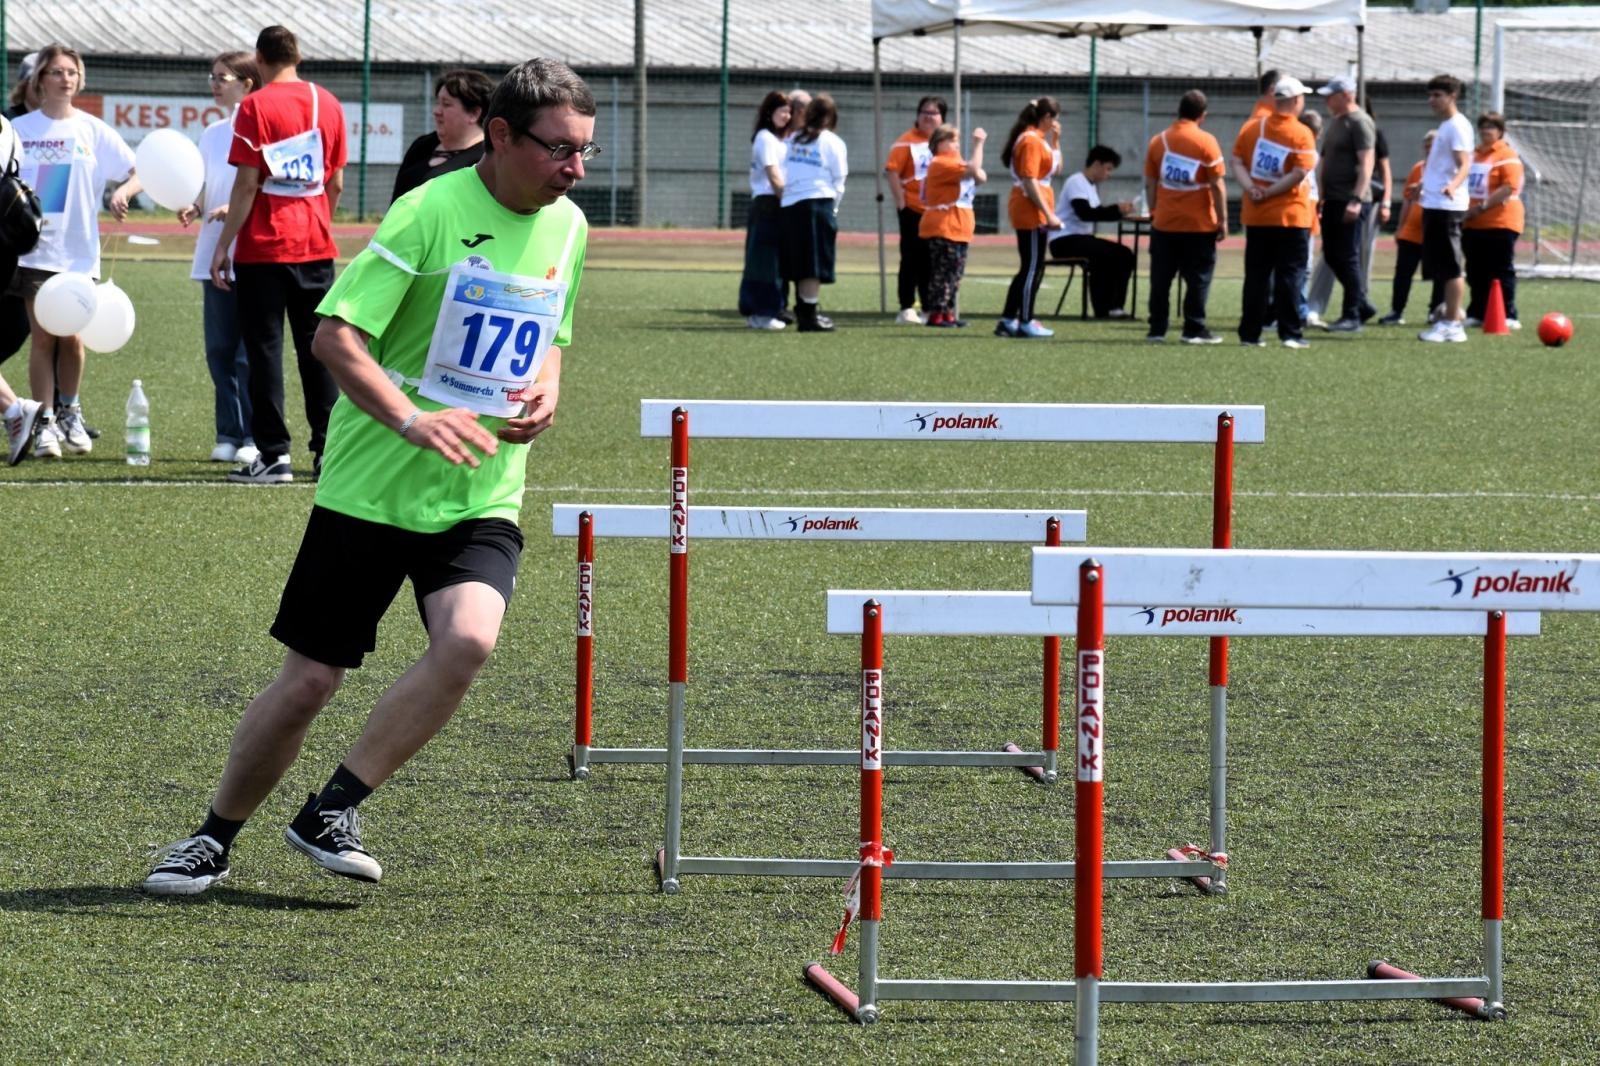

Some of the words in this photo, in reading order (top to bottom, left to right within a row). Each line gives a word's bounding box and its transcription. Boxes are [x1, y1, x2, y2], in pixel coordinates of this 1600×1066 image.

[115, 104, 171, 128] KES
[1256, 152, 1280, 172] 208
[459, 312, 541, 377] 179
[932, 412, 999, 433] polanik
[673, 469, 686, 546] POLANIK
[802, 515, 860, 534] polanik
[579, 564, 591, 631] POLANIK
[1471, 569, 1575, 599] polanik
[864, 671, 880, 761] POLANIK
[1080, 654, 1100, 770] POLANIK
